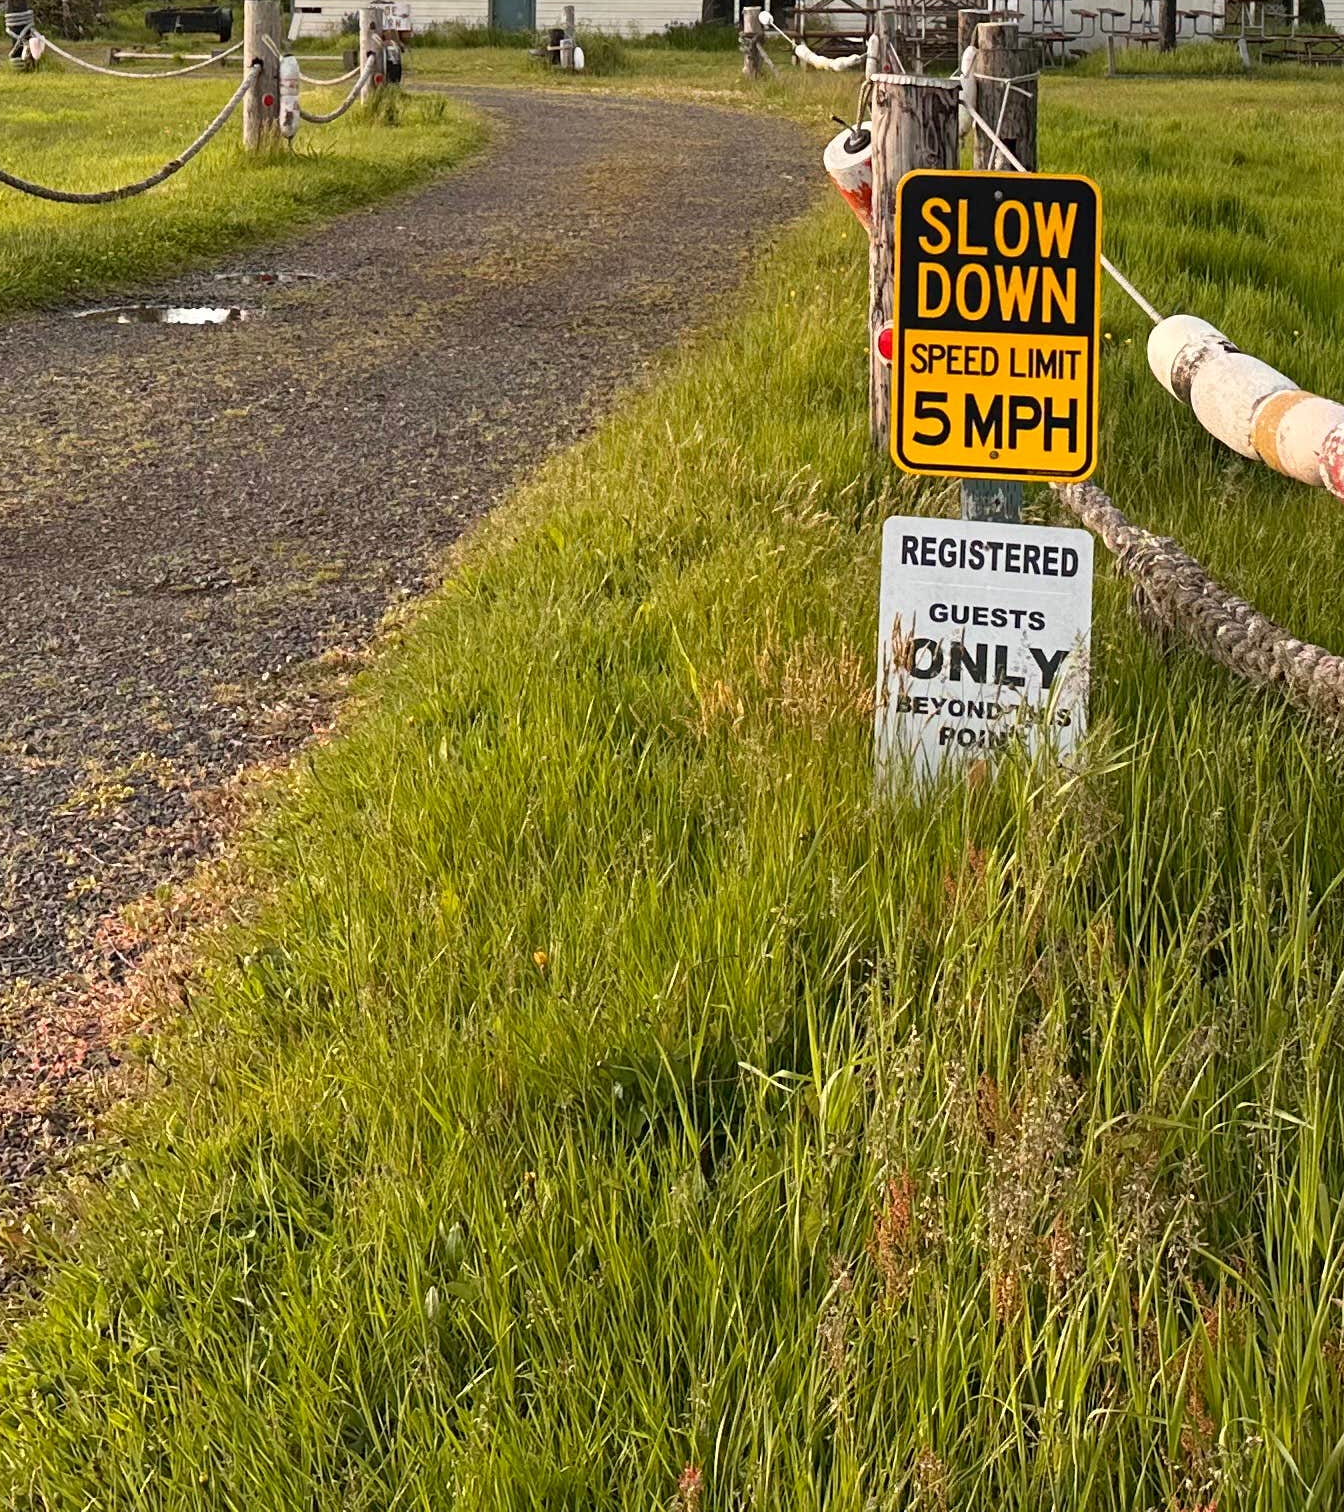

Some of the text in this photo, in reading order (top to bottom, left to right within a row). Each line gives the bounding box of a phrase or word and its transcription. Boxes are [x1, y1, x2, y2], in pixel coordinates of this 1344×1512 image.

[918, 198, 1078, 259] SLOW
[917, 262, 1077, 325] DOWN
[910, 343, 1082, 380] SPEED LIMIT
[912, 390, 1078, 453] 5 MPH
[900, 535, 1079, 577] REGISTERED
[929, 603, 1045, 631] GUESTS
[907, 637, 1072, 689] ONLY
[895, 695, 1002, 720] BEYOND
